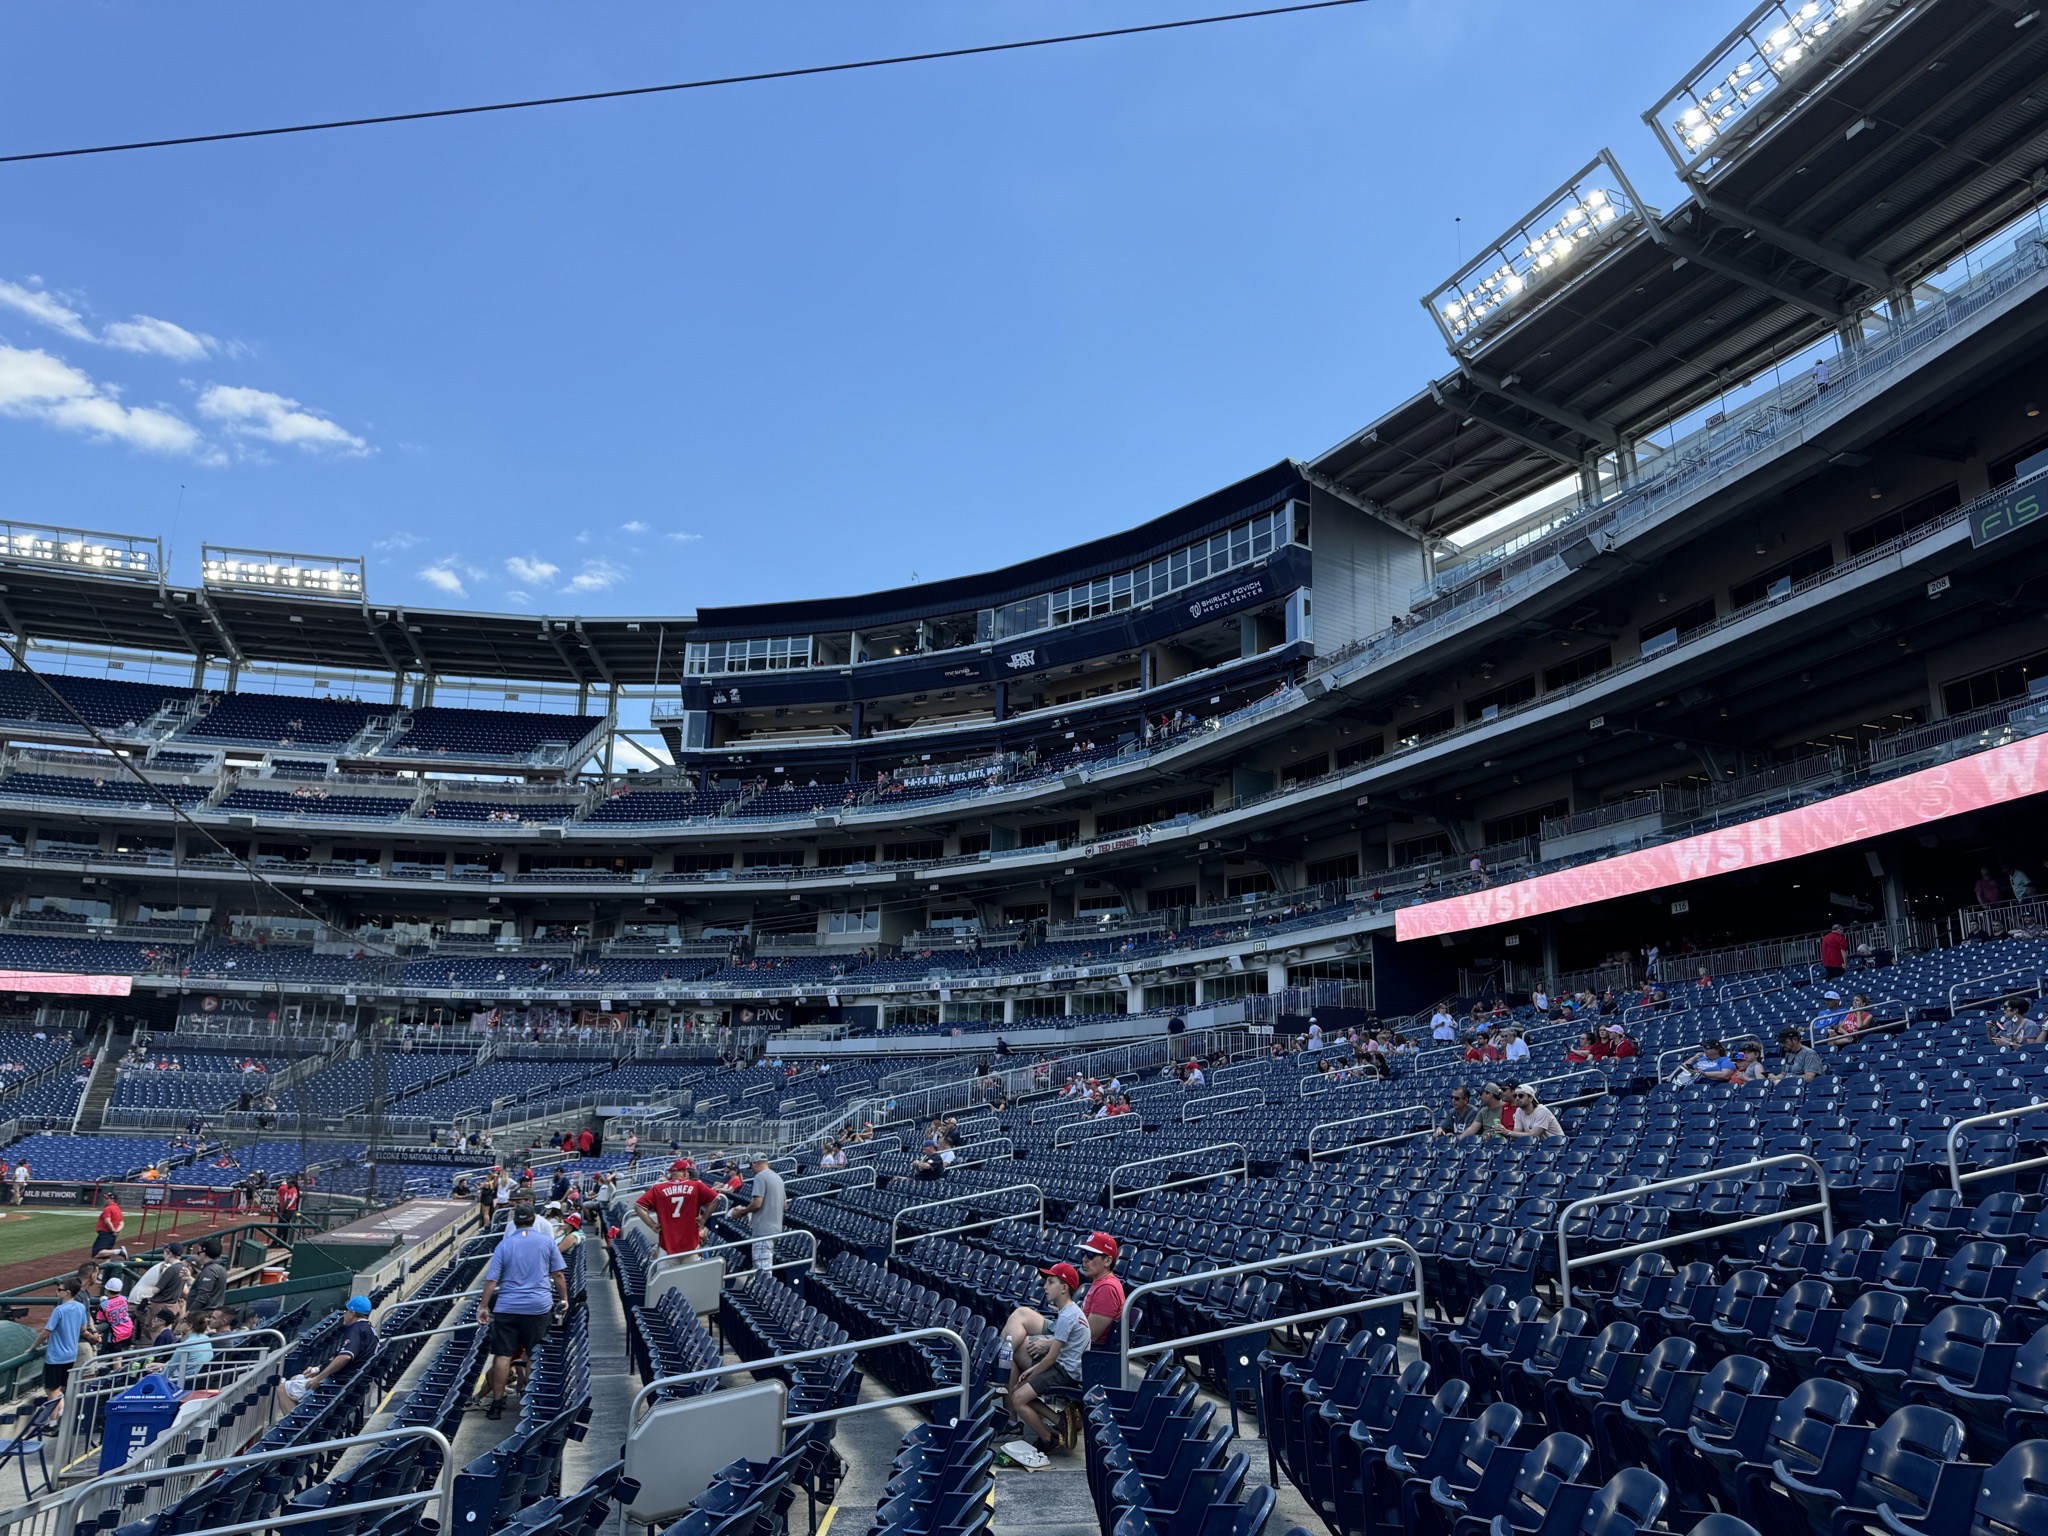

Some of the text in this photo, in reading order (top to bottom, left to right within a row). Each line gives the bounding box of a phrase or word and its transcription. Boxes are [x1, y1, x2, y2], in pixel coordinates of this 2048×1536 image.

[1931, 579, 1947, 592] 208
[1201, 580, 1261, 607] SHIRLEY POVICH
[1203, 587, 1264, 613] MEDIA CENTER
[1591, 717, 1603, 728] 209
[1098, 838, 1138, 853] TED LERNER
[1464, 881, 1538, 927] WSH
[1671, 817, 1782, 880] WSH
[1674, 902, 1687, 912] 116
[1507, 936, 1518, 945] 117
[1254, 942, 1266, 952] 119
[1052, 970, 1077, 980] CARTER
[1089, 966, 1118, 976] DAWSON
[978, 979, 995, 987] RICE
[1023, 974, 1041, 983] WYNN
[895, 983, 931, 992] KILLEBREW
[940, 980, 968, 989] MANUSH
[348, 987, 379, 995] BROWN
[397, 989, 428, 997] GIBSON
[762, 989, 793, 997] GRIFFITH
[801, 987, 827, 995] HARRIS
[837, 986, 871, 994] JOHNSON
[221, 998, 257, 1012] PNC
[757, 1008, 784, 1021] PNC
[374, 1151, 400, 1160] ELCOME
[408, 1153, 437, 1161] NATIONALS
[454, 1154, 486, 1164] WASHINGTON
[24, 1190, 77, 1199] MLB NETWORK
[661, 1184, 694, 1197] TURNER
[671, 1196, 684, 1219] 7
